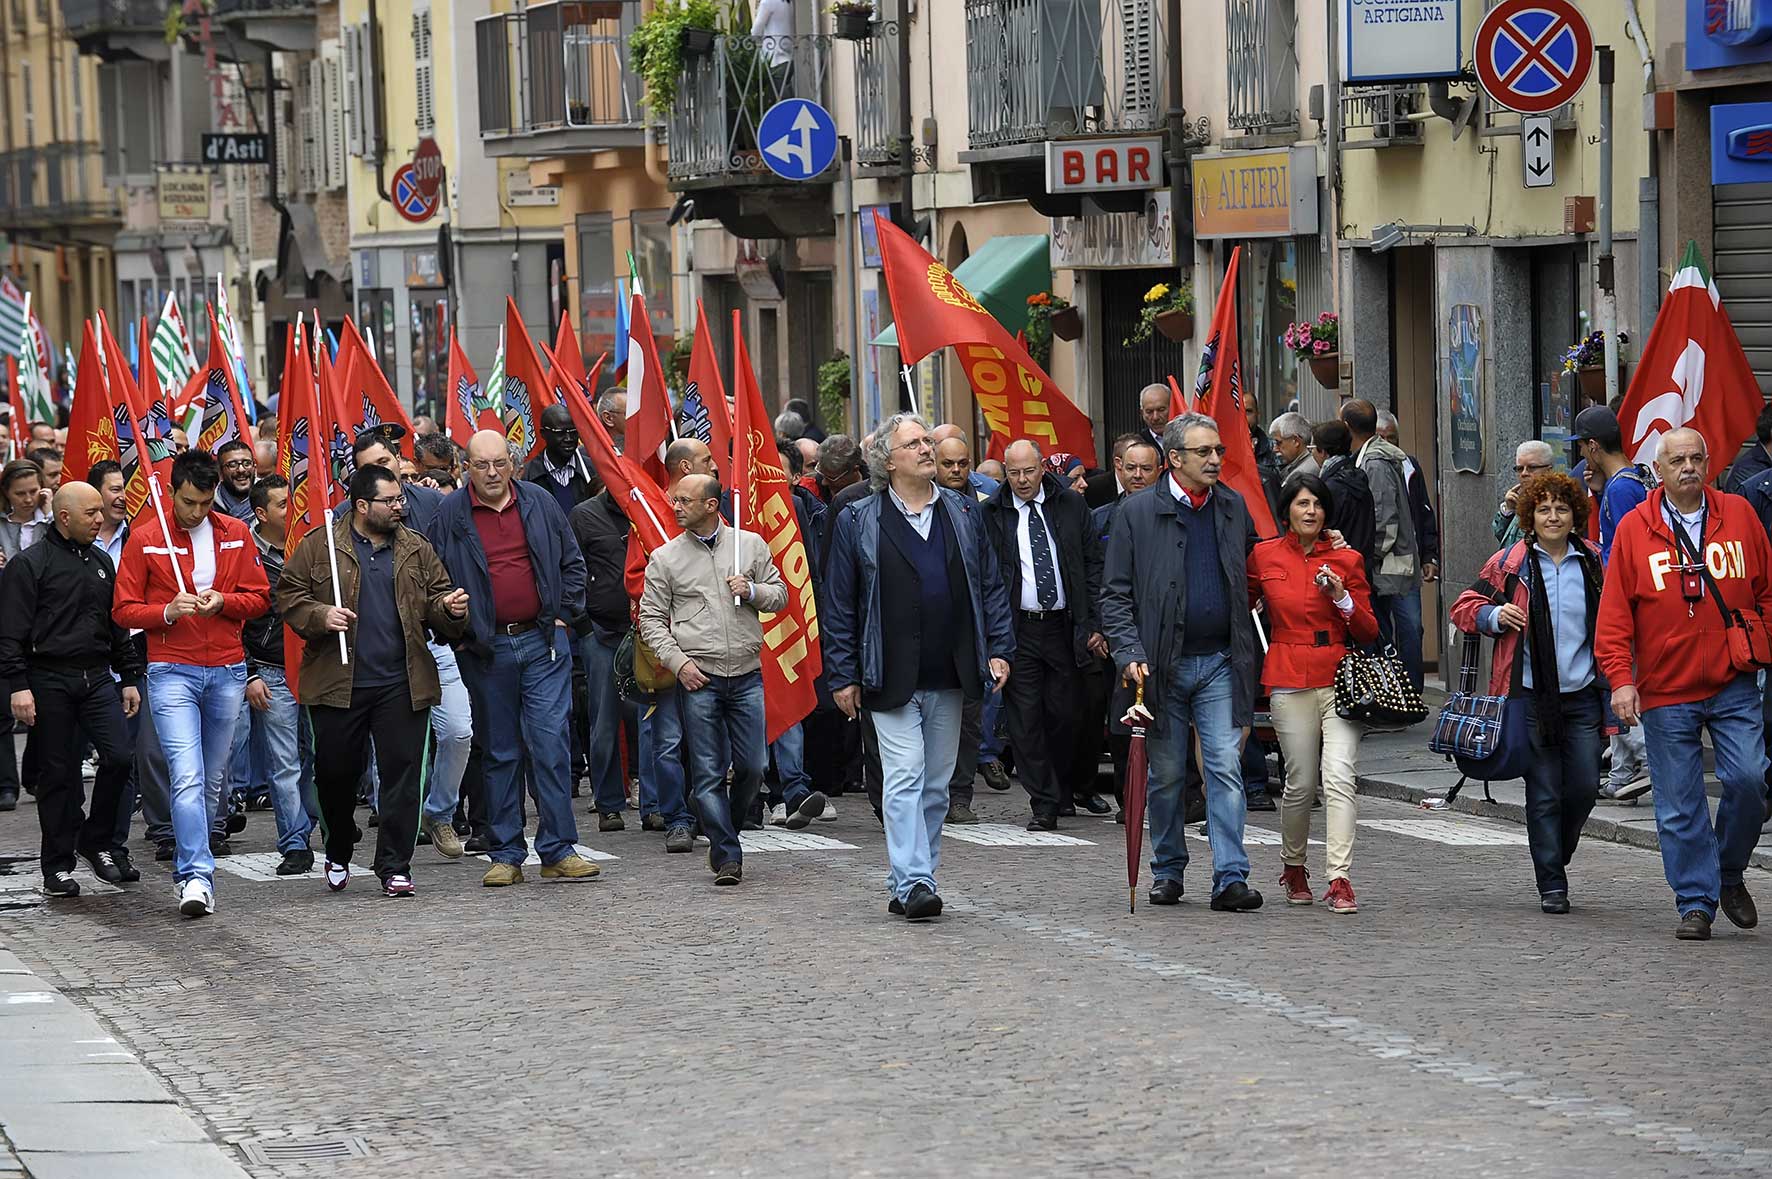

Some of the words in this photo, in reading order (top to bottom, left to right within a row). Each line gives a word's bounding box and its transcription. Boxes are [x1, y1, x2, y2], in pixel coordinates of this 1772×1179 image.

[1364, 6, 1444, 24] ARTIGIANA
[206, 137, 264, 160] d'Asti
[415, 155, 441, 181] STOP
[1062, 146, 1151, 186] BAR
[1217, 165, 1288, 210] ALFIERI
